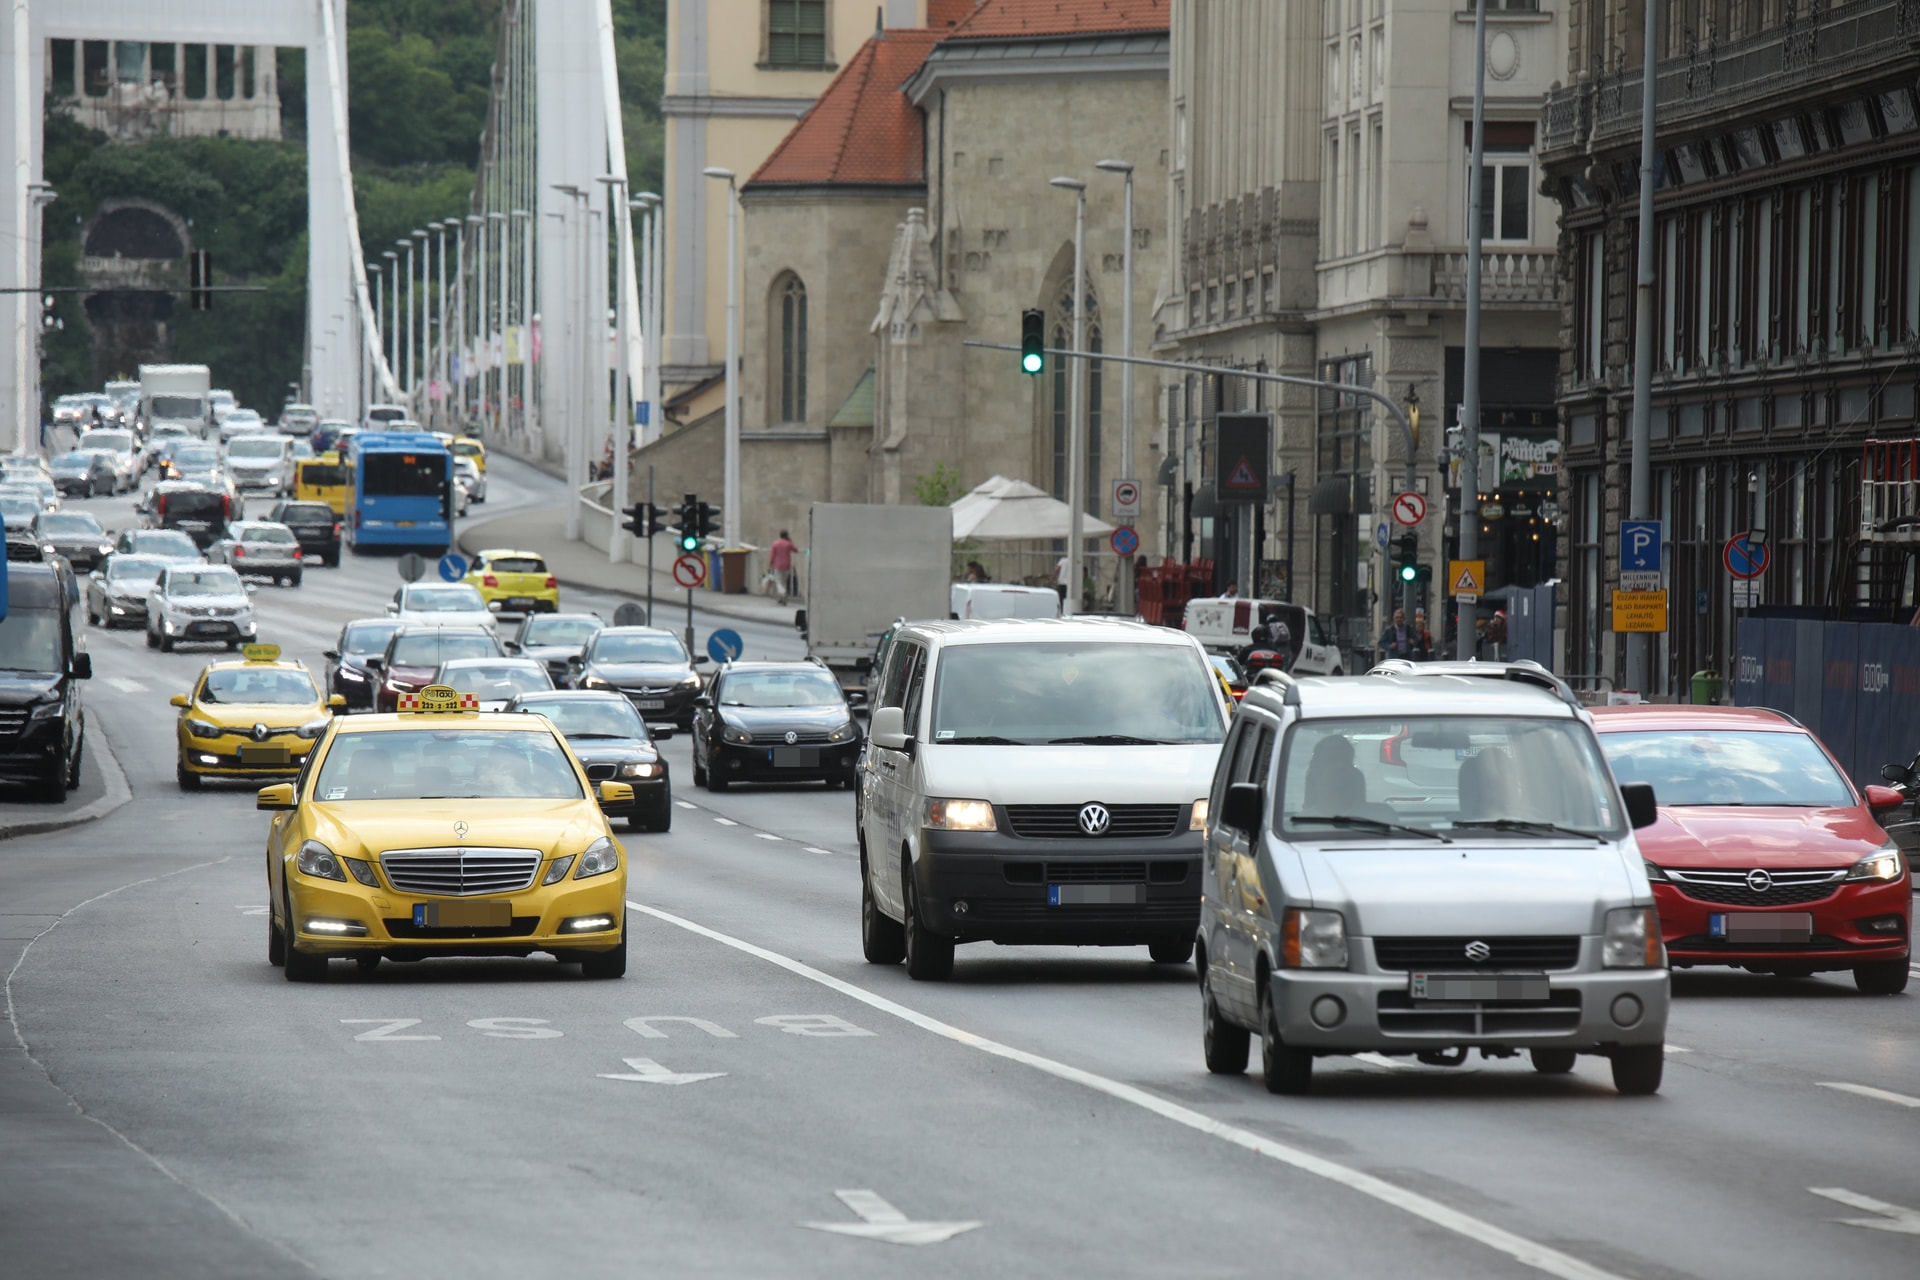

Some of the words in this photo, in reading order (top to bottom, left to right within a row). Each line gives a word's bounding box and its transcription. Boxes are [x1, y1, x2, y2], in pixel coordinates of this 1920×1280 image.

[1502, 441, 1560, 463] Pointer
[1507, 437, 1529, 448] The
[1634, 533, 1650, 555] P
[1622, 573, 1659, 581] MILLENNIUM
[339, 1014, 880, 1042] BUSZ
